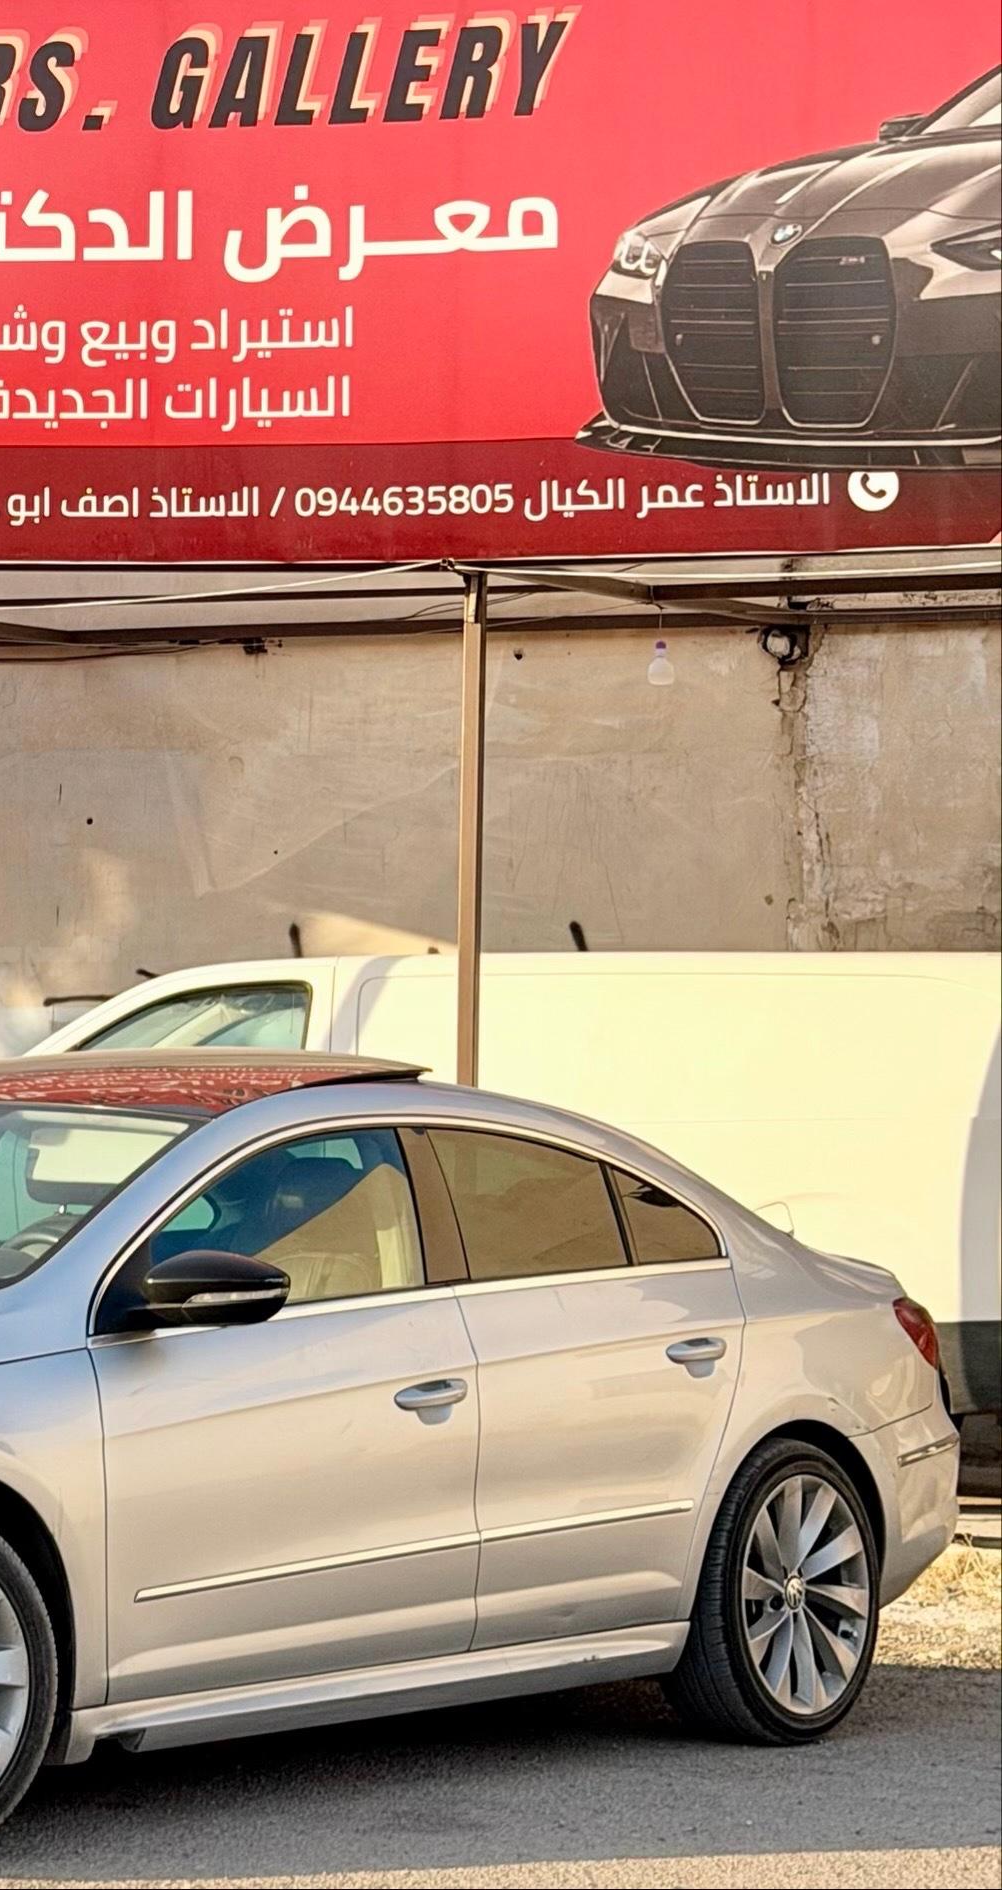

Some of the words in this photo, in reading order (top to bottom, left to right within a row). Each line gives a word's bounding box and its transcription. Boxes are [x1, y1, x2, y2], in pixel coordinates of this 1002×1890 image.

[151, 21, 568, 130] GALLERY
[223, 184, 559, 283] معرض
[80, 319, 176, 368] وبيع
[190, 305, 353, 363] استيراد
[164, 375, 350, 432] السيارات
[7, 486, 50, 526] ابو
[60, 487, 139, 518] اصف
[149, 486, 259, 518] الاستاذ
[294, 483, 514, 517] 0944635805
[524, 478, 625, 522] الكيال
[636, 483, 705, 519] عمر
[713, 472, 830, 507] الاستاذ
